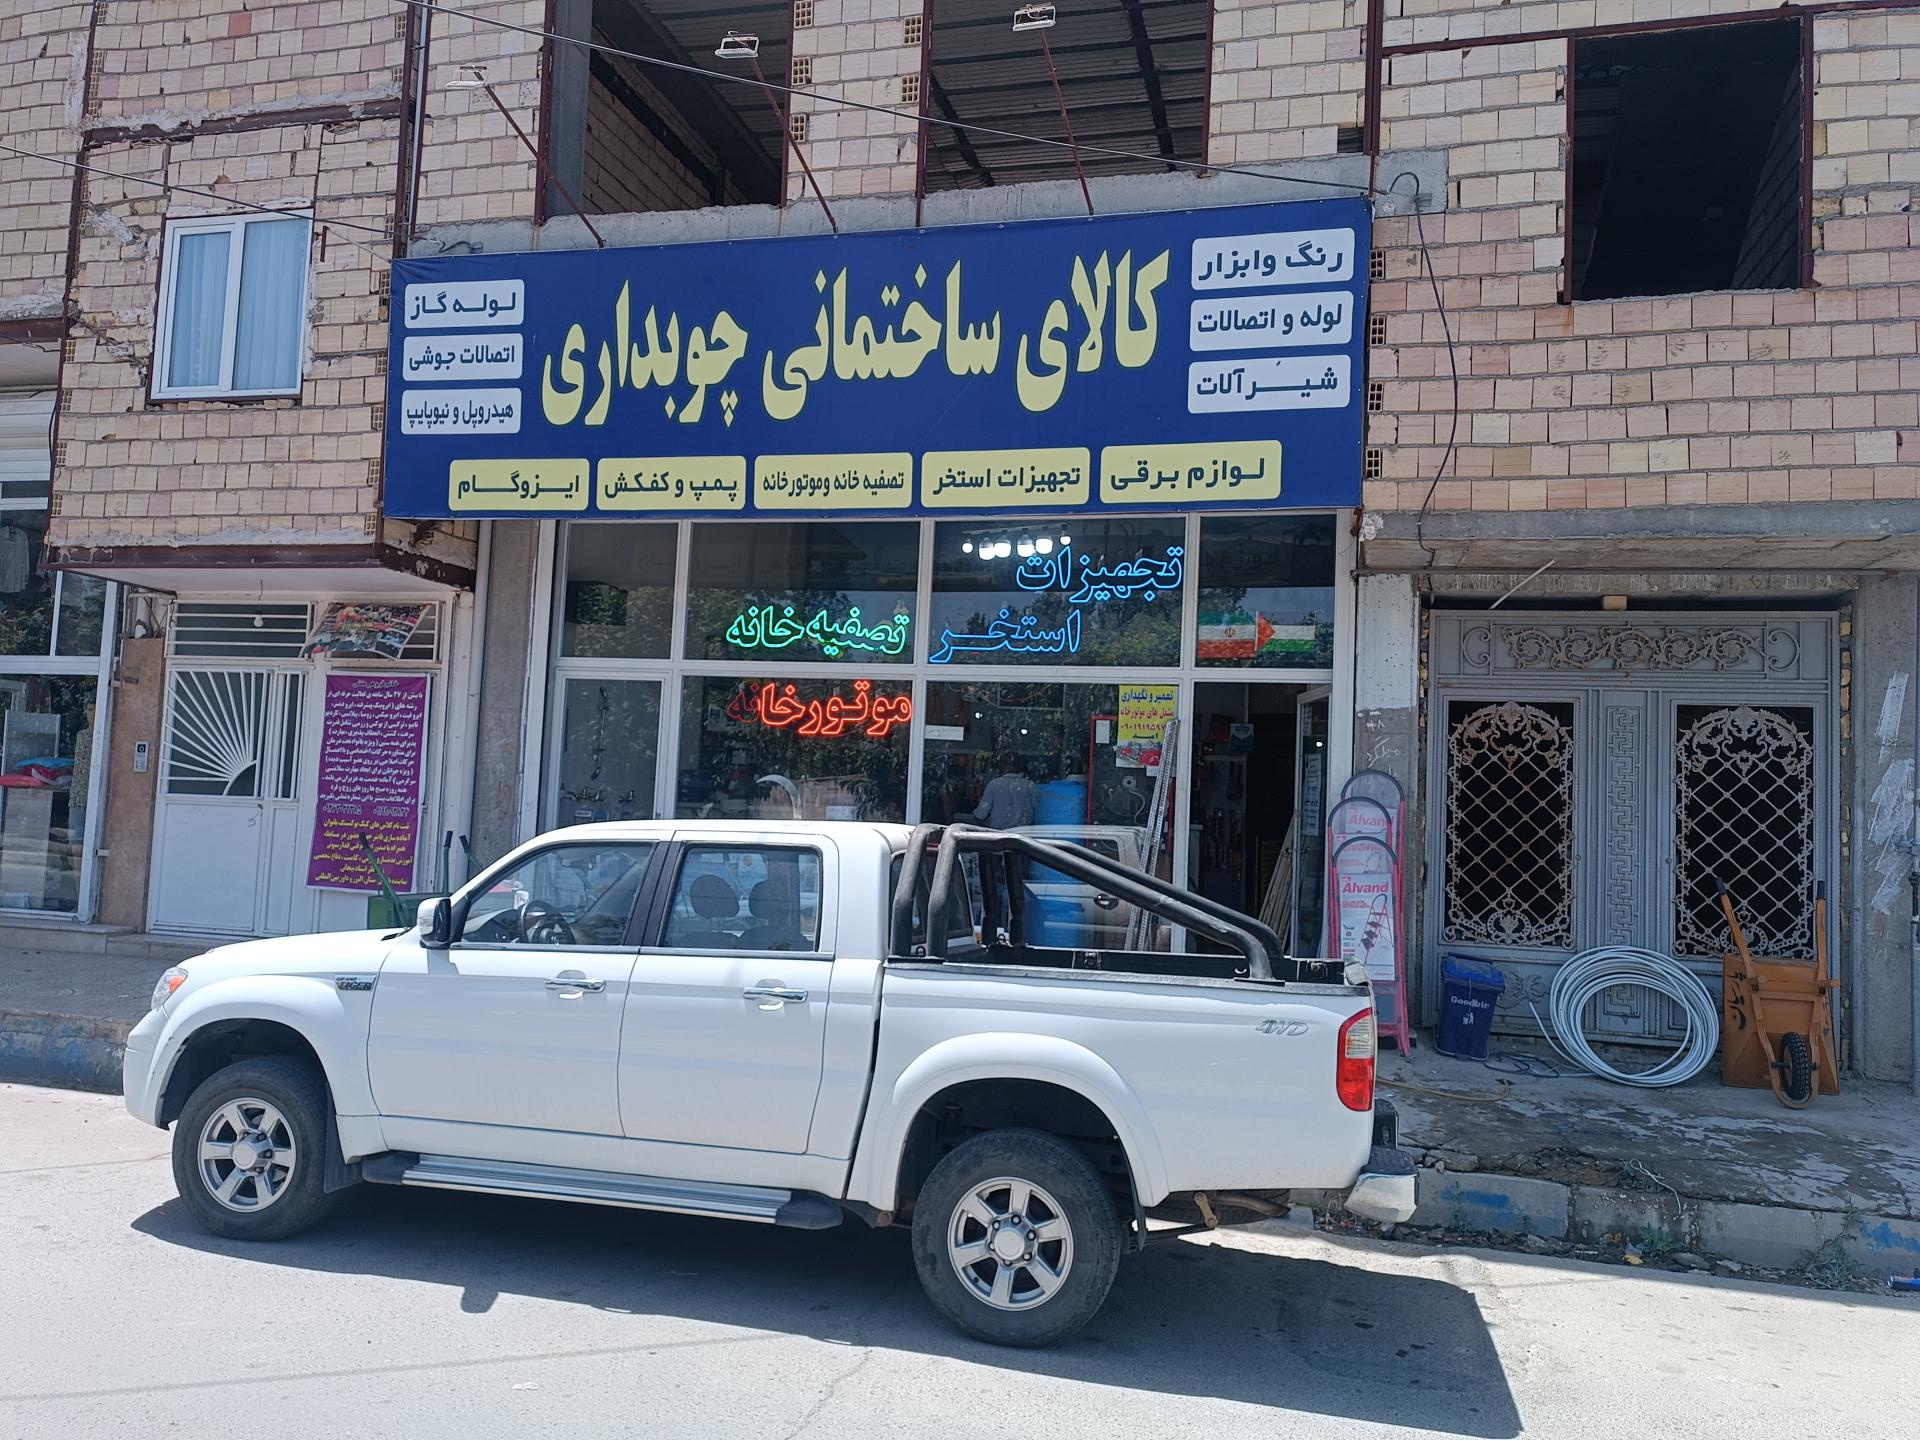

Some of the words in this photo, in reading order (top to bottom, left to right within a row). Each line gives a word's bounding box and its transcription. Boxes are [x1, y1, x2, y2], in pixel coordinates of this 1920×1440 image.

[1286, 241, 1342, 272] رنگ
[411, 291, 446, 320] گاز
[453, 292, 516, 317] لوله
[1016, 249, 1170, 412] کالای
[1198, 309, 1275, 332] اتصالات
[1283, 314, 1293, 335] و
[1301, 304, 1342, 333] لوله
[762, 258, 1001, 420] ساختمانی
[410, 346, 455, 371] جوشی
[460, 345, 514, 363] اتصالات
[541, 279, 748, 427] چوبداری
[407, 401, 449, 429] نیوپایپ
[453, 406, 459, 424] و
[463, 400, 513, 428] هیدروپل
[605, 472, 668, 498] کفکش
[834, 470, 859, 489] خانه
[863, 470, 904, 495] تصفیه
[933, 469, 990, 495] استخر
[998, 466, 1080, 492] تجهیزات
[1111, 461, 1179, 490] برقی
[1188, 458, 1264, 488] لوازم
[675, 479, 683, 497] و
[690, 479, 737, 501] پمپ
[1016, 545, 1184, 603] تجهیزات
[726, 605, 804, 648] خانه
[807, 607, 910, 657] تصفیه
[930, 609, 1081, 663] استخر
[1121, 689, 1147, 702] نگهداری
[1149, 693, 1152, 702] و
[1155, 690, 1173, 703] تعمیر
[1147, 707, 1157, 718] های
[1160, 708, 1175, 718] مشعل
[1342, 881, 1389, 893] Alvand
[1450, 996, 1490, 1009] Goodbin
[1255, 1020, 1309, 1036] 4WD
